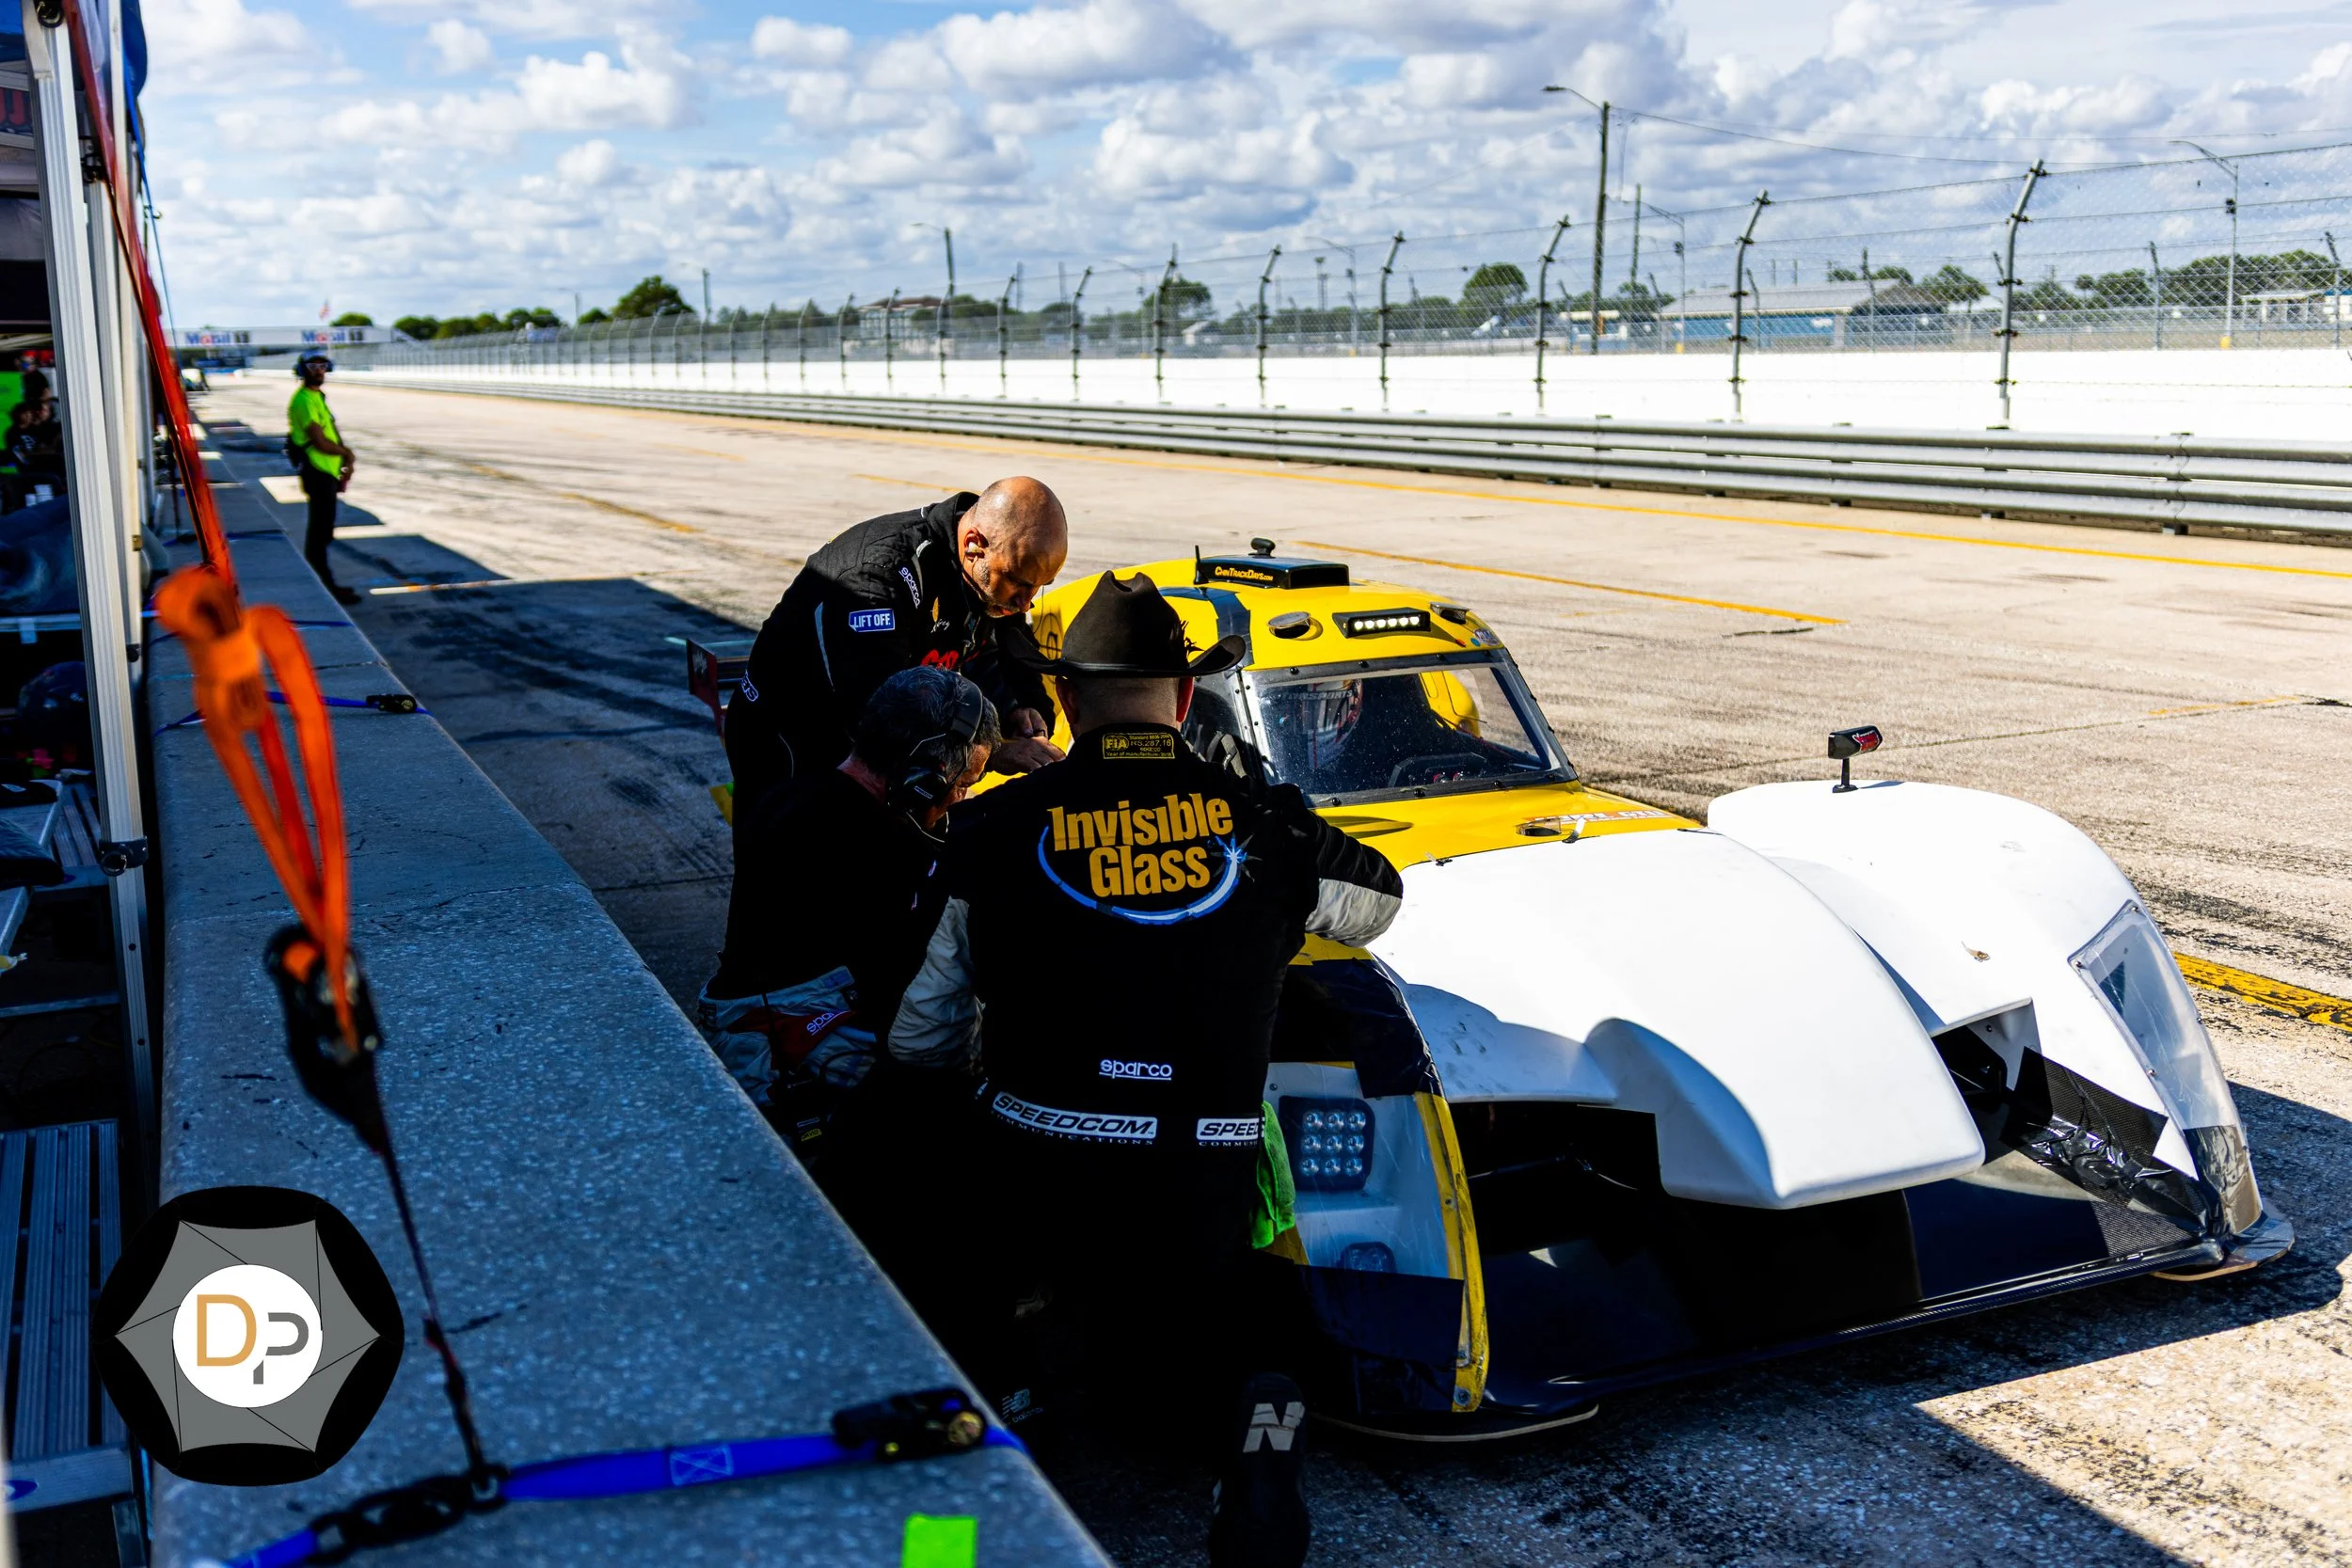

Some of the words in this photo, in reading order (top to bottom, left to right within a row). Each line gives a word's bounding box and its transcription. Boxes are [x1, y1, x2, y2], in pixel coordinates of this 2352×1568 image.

[853, 614, 873, 628] LIFT
[1105, 738, 1128, 750] FIA
[1046, 793, 1234, 852] Invisible
[1089, 844, 1211, 897] Glass
[1099, 1059, 1172, 1080] sparco
[990, 1110, 1153, 1146] COMMUNICATIONS
[994, 1095, 1154, 1135] SPEEDCOM
